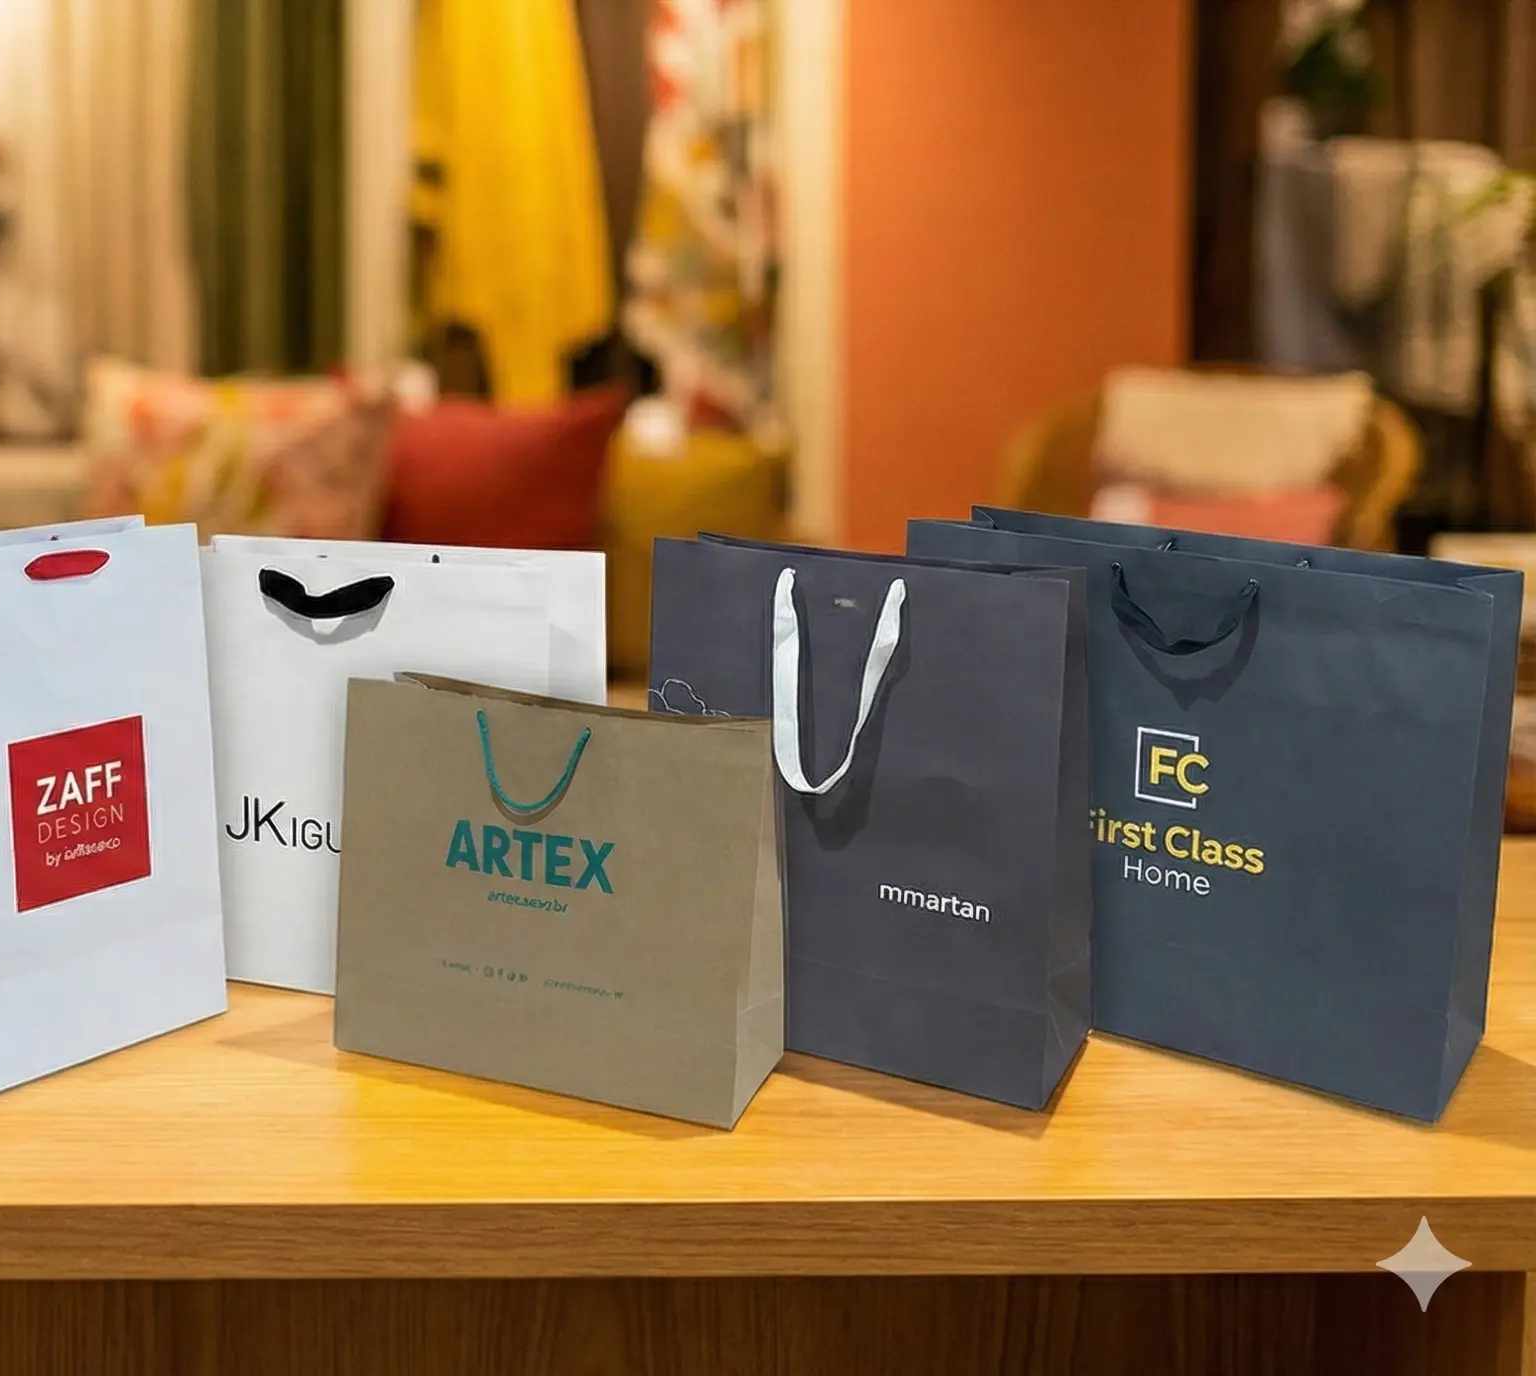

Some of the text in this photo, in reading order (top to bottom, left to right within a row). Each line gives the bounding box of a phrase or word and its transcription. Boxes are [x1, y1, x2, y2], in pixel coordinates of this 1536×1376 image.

[36, 759, 123, 816] ZAFF
[1149, 745, 1211, 795] FC
[37, 803, 125, 845] DESIGN
[1089, 807, 1265, 875] irst Class
[45, 851, 63, 868] by
[445, 819, 616, 895] ARTEX
[1123, 855, 1211, 896] Home
[879, 883, 991, 923] mmartan
